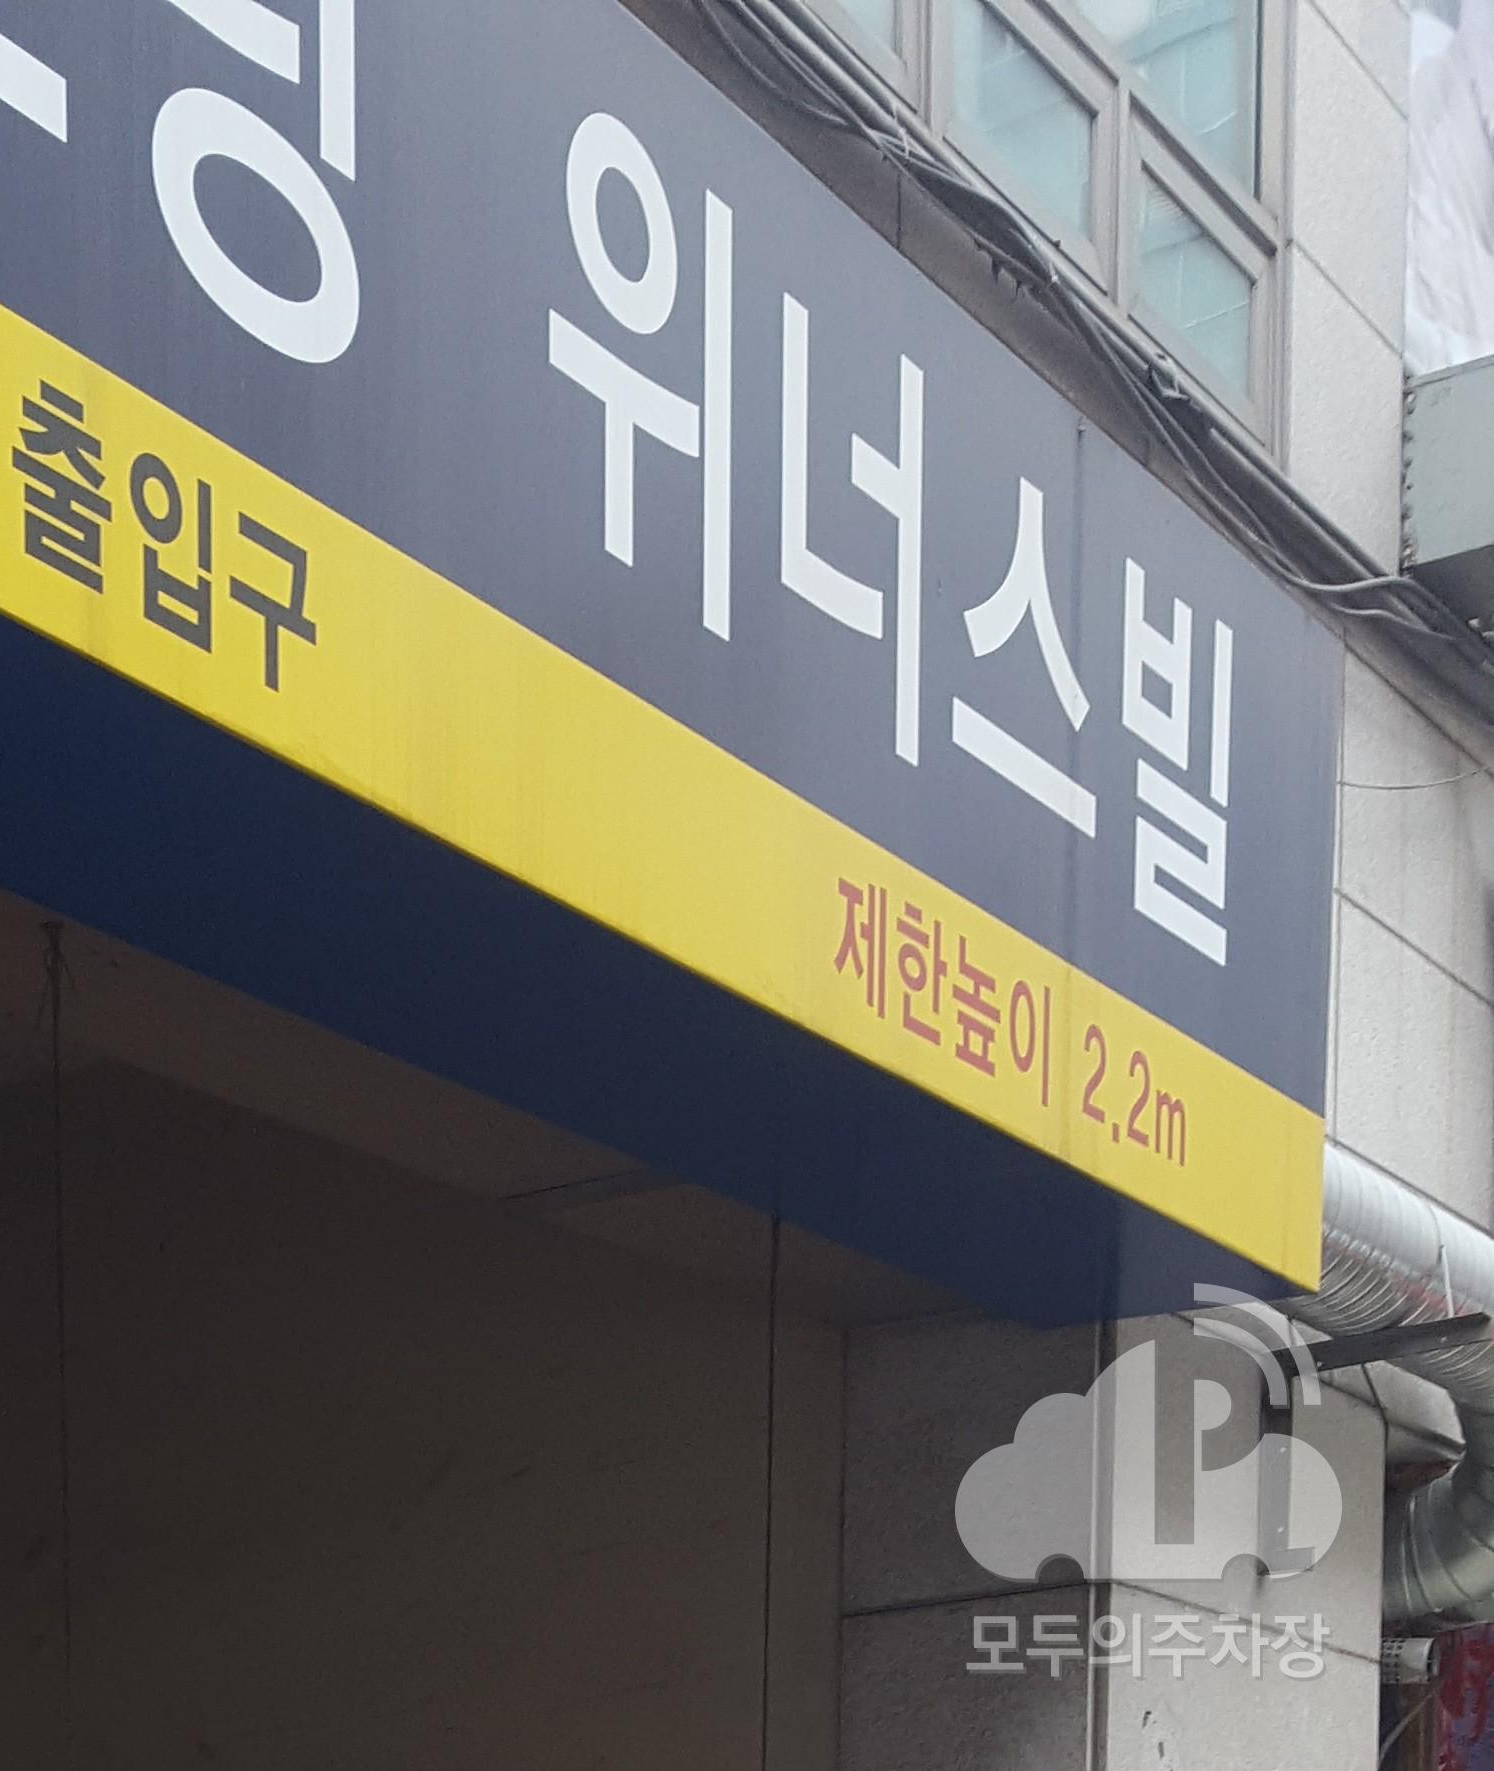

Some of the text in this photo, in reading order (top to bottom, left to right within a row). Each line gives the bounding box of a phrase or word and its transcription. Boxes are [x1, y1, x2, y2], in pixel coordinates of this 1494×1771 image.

[549, 112, 1233, 965] 위너스빌
[834, 877, 1186, 1167] 제한높이 2.2m
